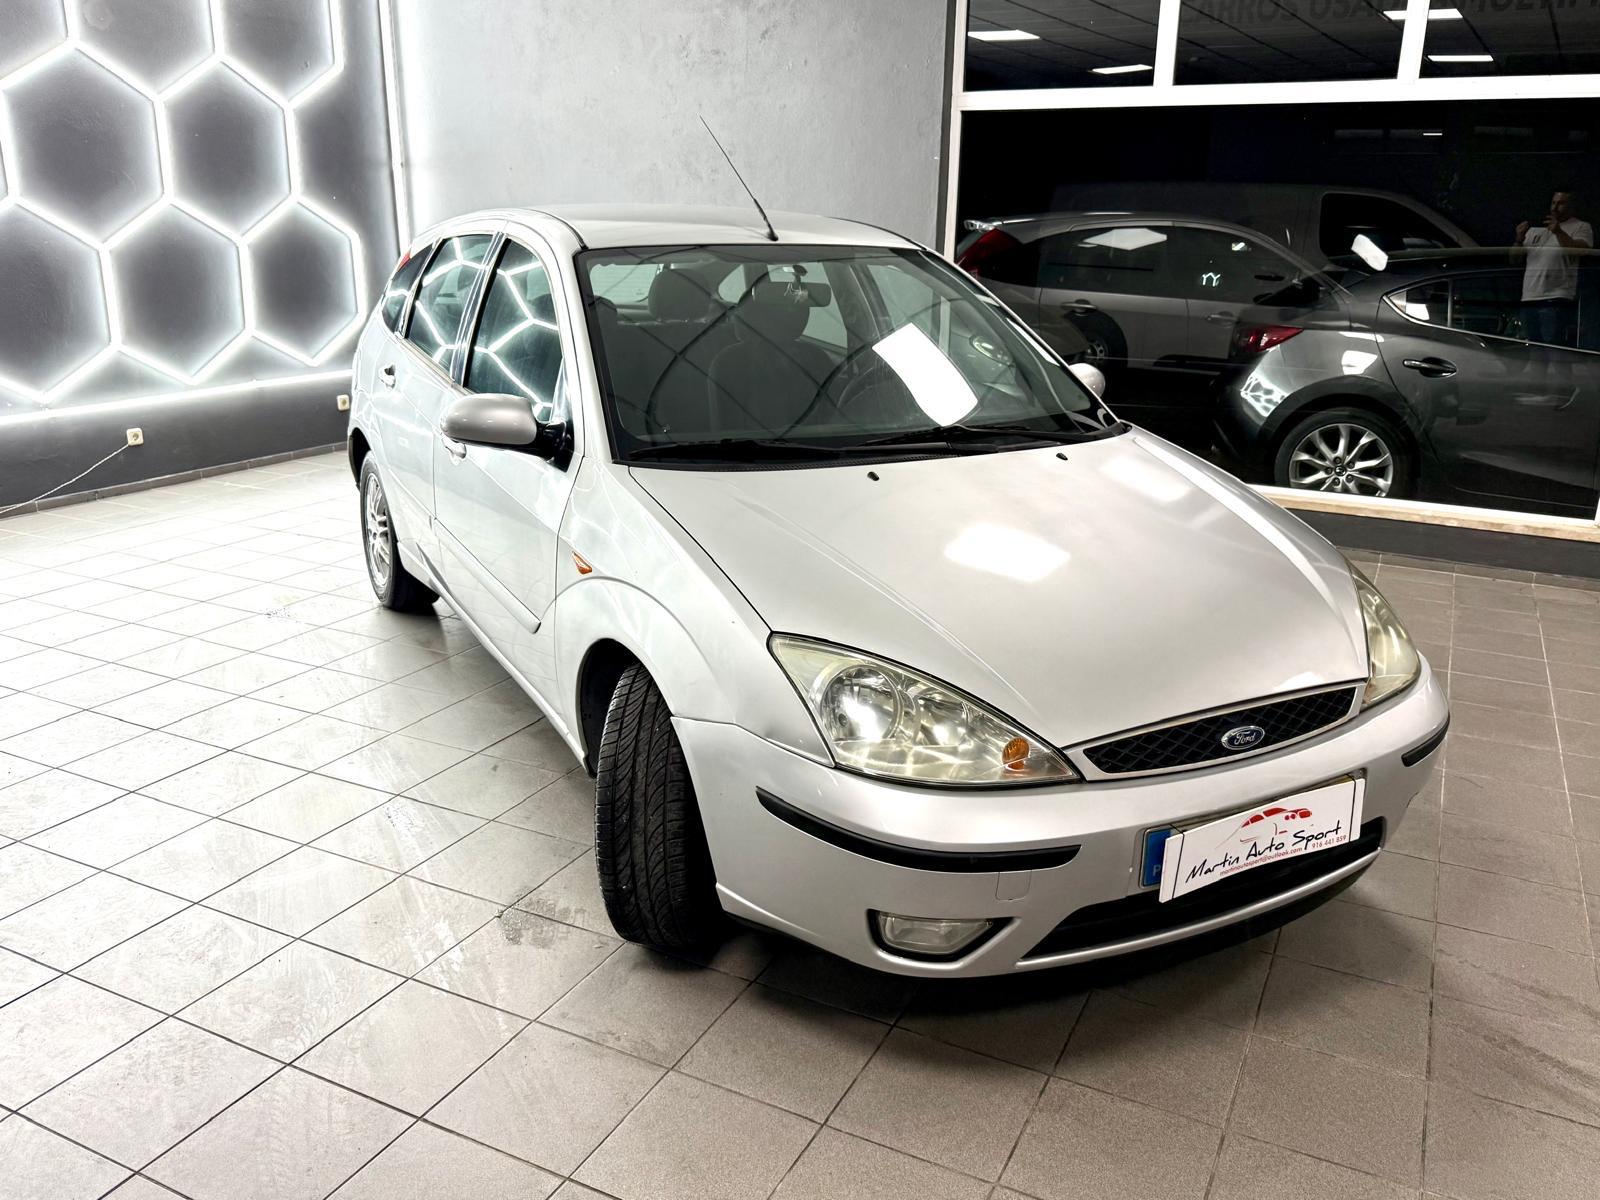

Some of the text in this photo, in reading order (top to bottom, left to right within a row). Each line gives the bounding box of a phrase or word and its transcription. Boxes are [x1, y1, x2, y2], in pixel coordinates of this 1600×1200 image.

[1185, 820, 1342, 883] Martin Auto Sport
[1311, 841, 1323, 849] 916
[1324, 838, 1335, 846] 441
[1336, 835, 1347, 843] 859
